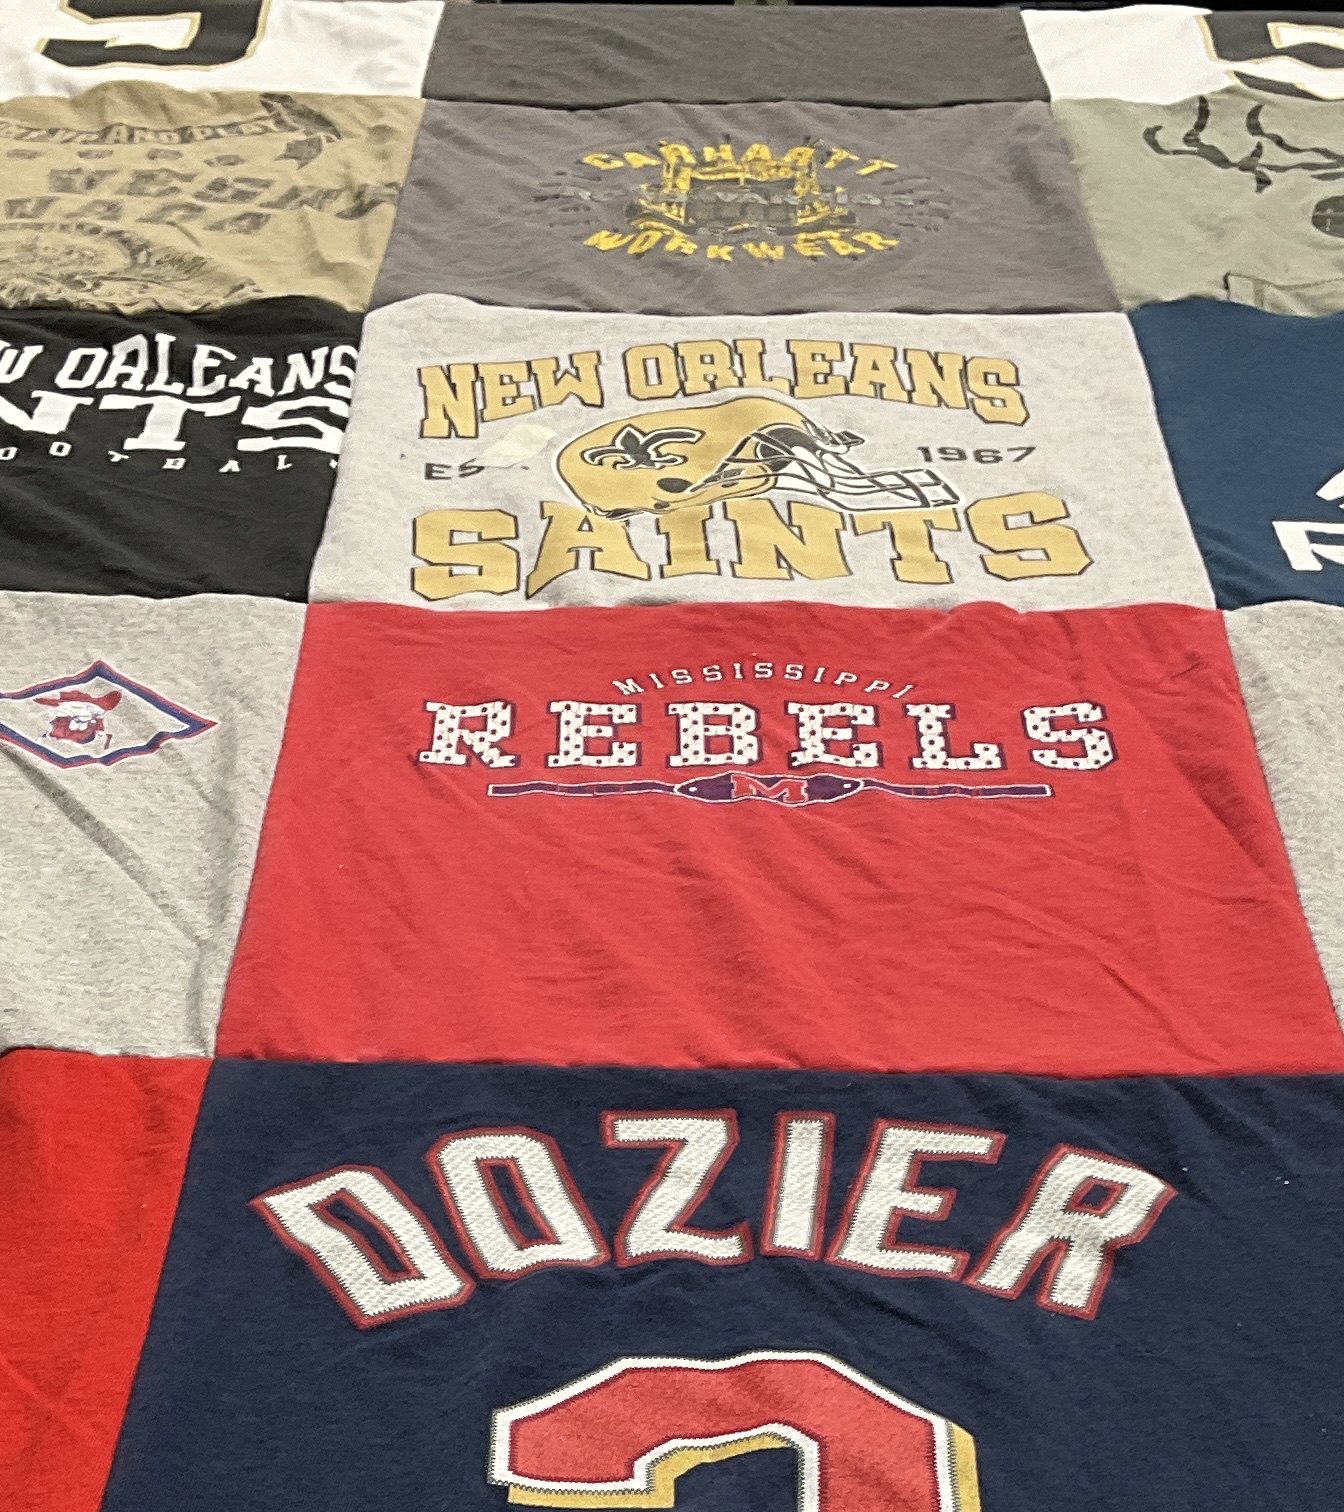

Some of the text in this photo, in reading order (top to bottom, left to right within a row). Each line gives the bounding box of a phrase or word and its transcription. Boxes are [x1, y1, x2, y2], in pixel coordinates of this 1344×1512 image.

[108, 122, 182, 144] AND
[582, 142, 900, 176] CARHARTT
[582, 228, 900, 262] WORKWEAR
[55, 332, 358, 398] ORLEANS
[418, 338, 1030, 439] NEW ORLEANS
[916, 445, 1037, 466] 1967
[411, 490, 1093, 601] SAINTS
[612, 662, 914, 699] MISSISSIPPI
[419, 699, 1120, 772] REBELS
[249, 1108, 1178, 1330] DOZIER
